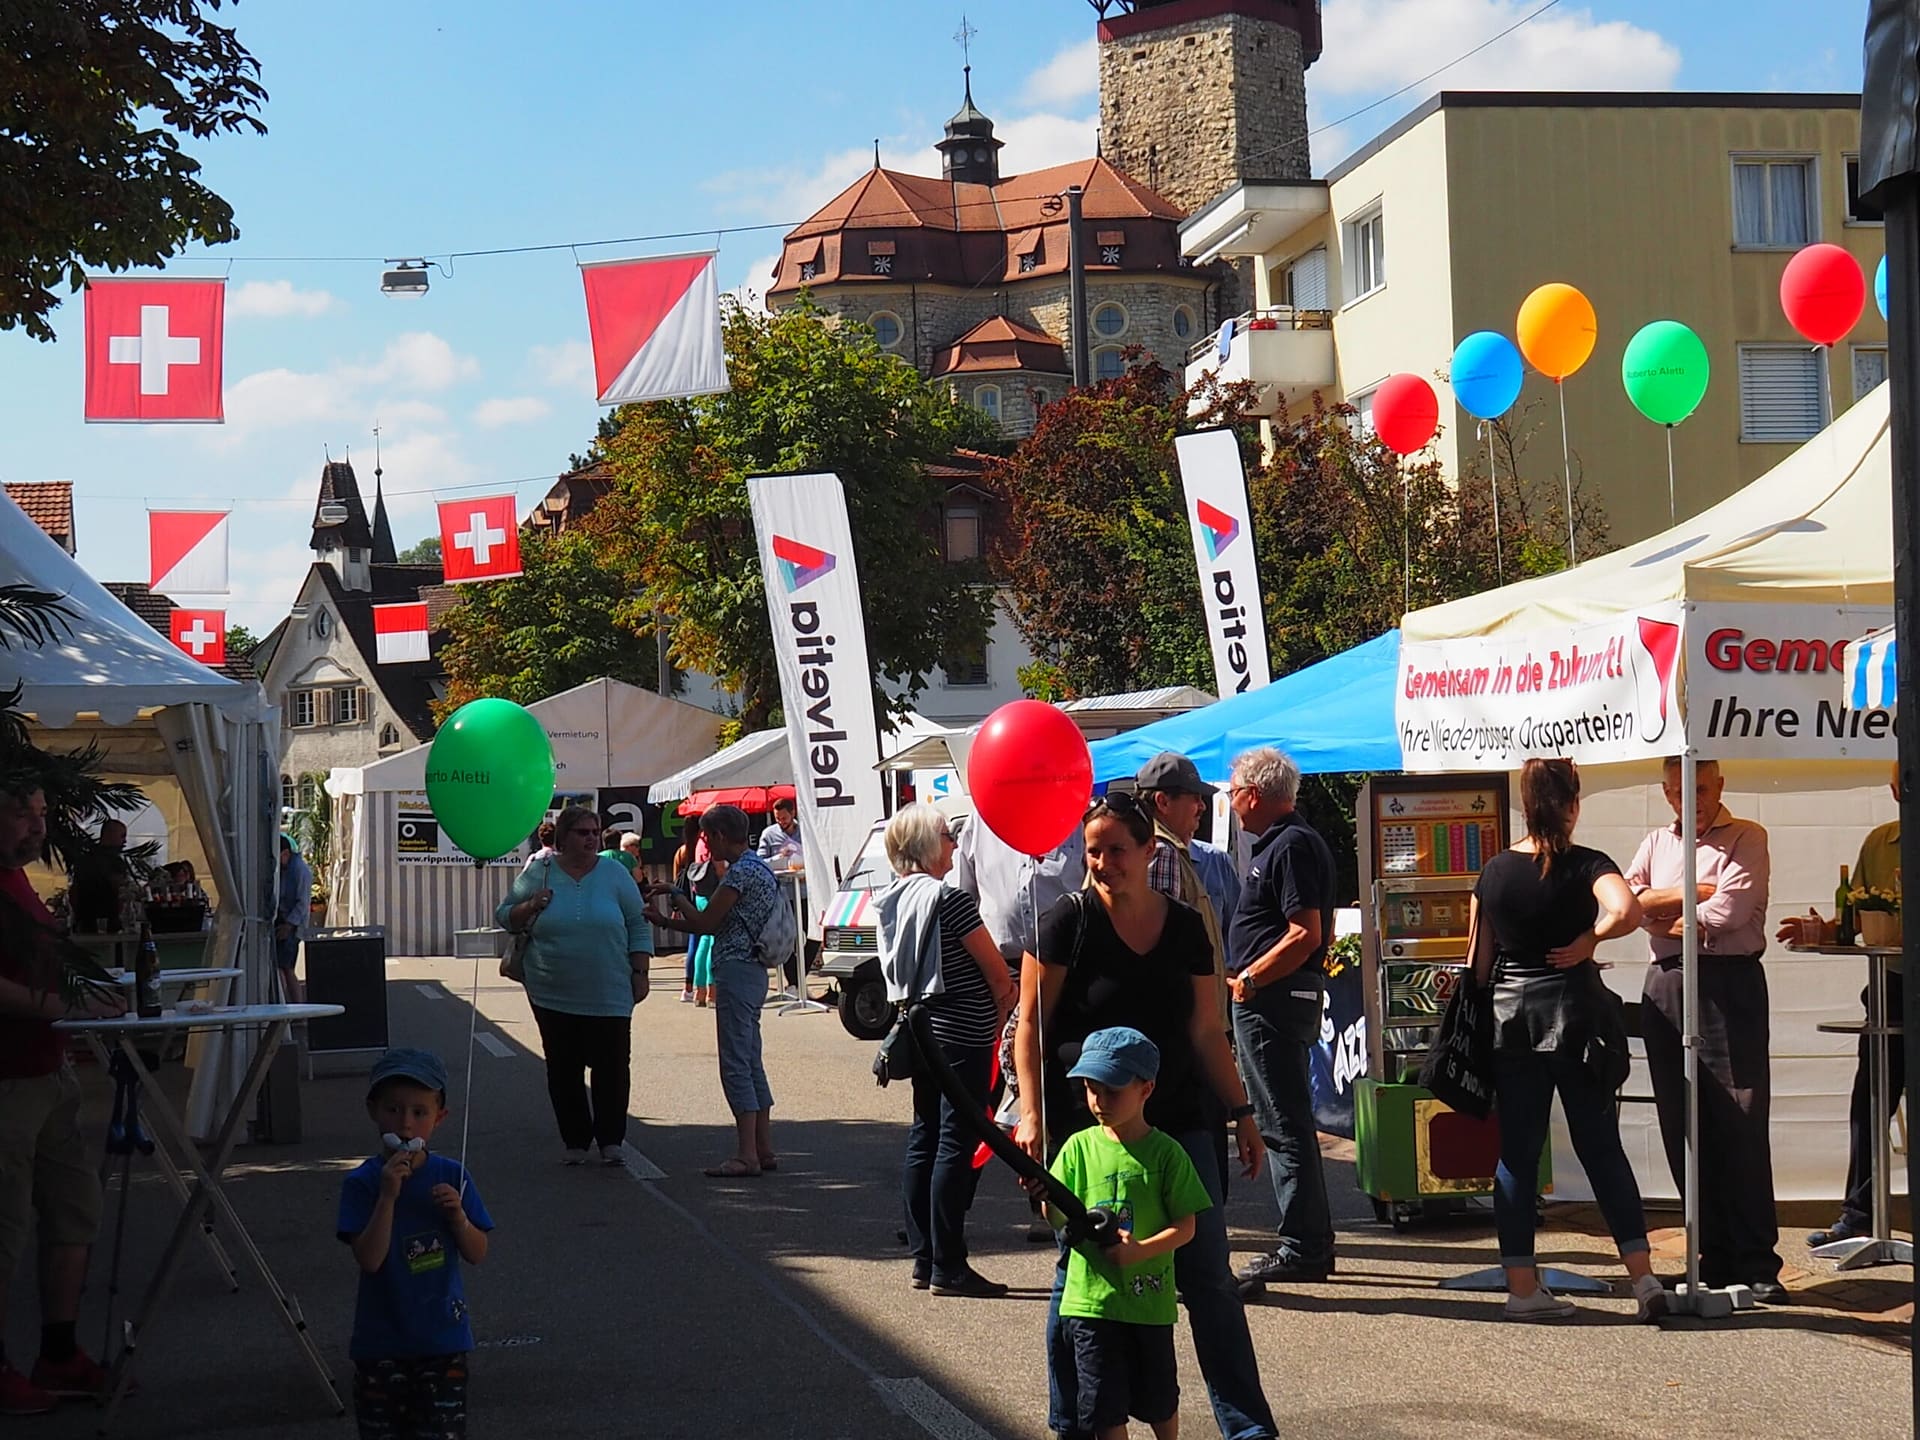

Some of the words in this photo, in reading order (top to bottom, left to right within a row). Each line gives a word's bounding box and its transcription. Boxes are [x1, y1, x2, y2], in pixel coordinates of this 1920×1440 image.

[1705, 628, 1852, 673] Geme
[1491, 656, 1513, 694] in
[1516, 653, 1543, 693] die
[547, 730, 599, 740] Vermietung
[1519, 704, 1634, 756] Ortsparteien
[1707, 696, 1799, 737] Ihre
[1816, 699, 1899, 738] Nie
[451, 769, 490, 785] Aletti
